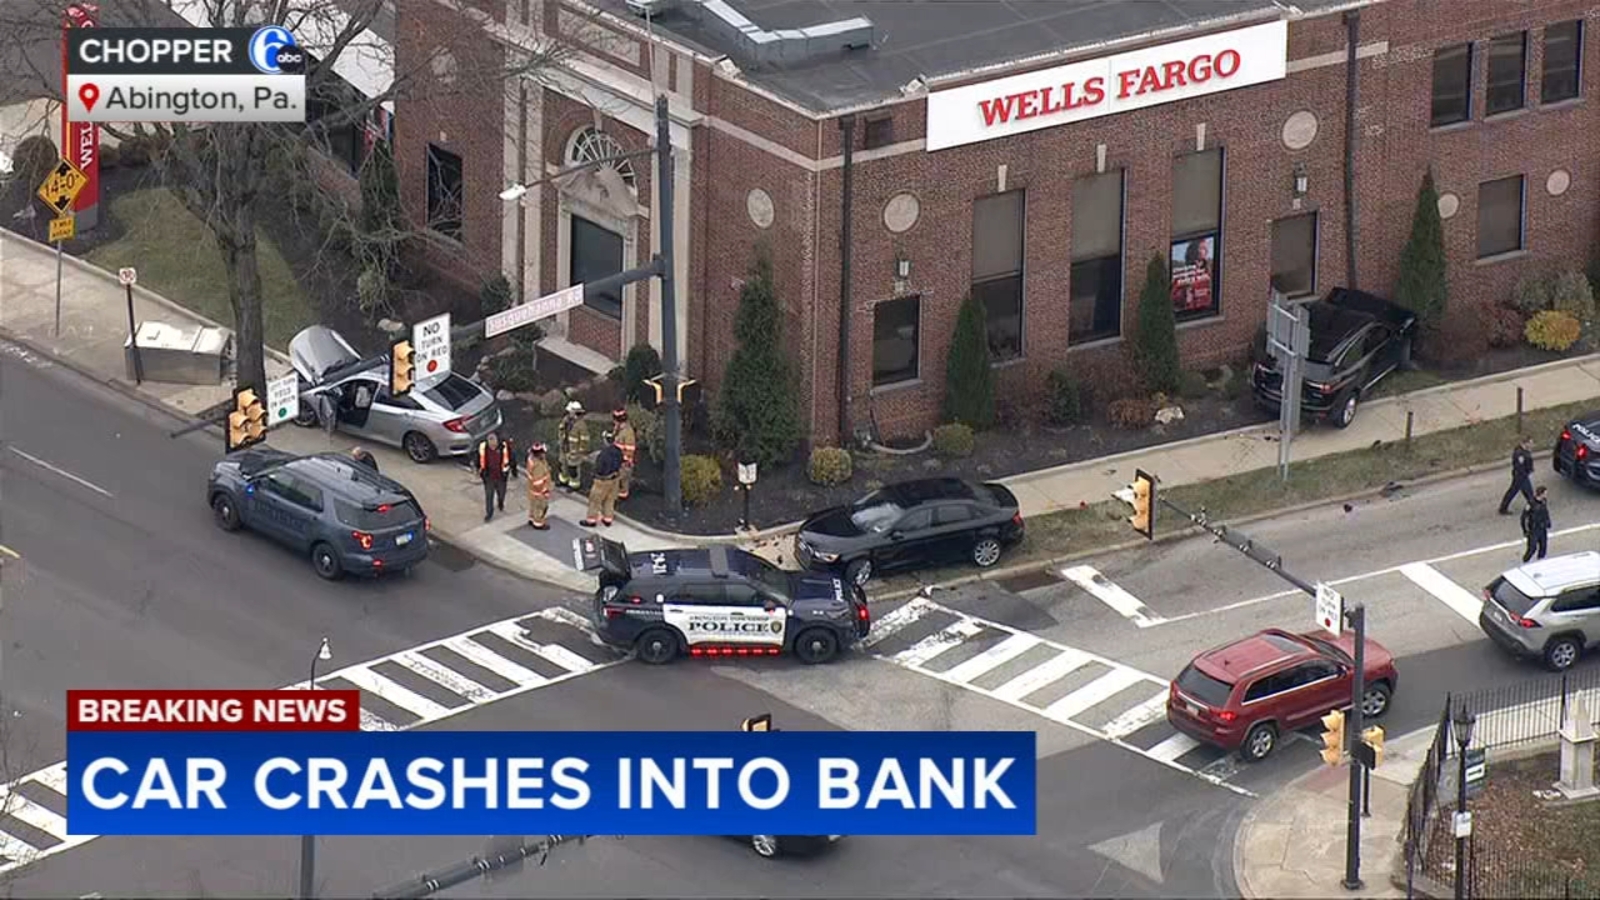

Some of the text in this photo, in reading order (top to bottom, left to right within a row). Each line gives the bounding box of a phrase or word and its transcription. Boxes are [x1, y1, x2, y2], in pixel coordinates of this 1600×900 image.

[979, 49, 1241, 127] WELLS FARGO
[80, 121, 94, 170] WEL
[423, 321, 440, 337] NO
[421, 336, 442, 350] TURN
[689, 622, 770, 632] POLICE
